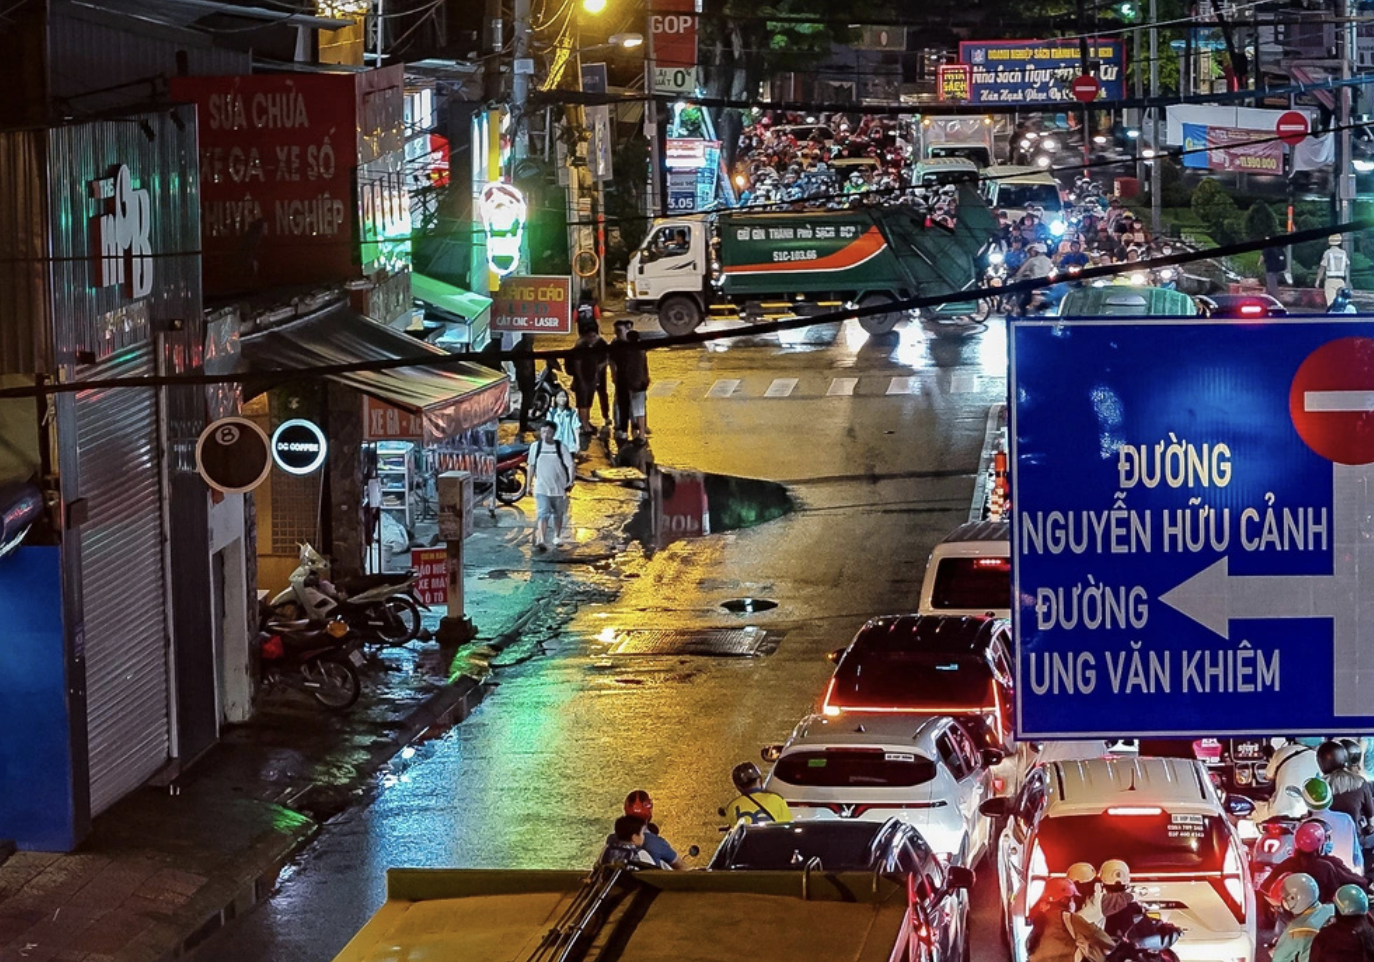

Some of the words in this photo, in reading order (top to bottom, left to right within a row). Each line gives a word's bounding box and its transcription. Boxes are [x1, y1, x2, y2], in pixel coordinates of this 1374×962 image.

[1118, 432, 1232, 488] ĐƯỜNG
[1022, 491, 1152, 555] NGUYỄN
[1162, 497, 1230, 553] HỮU
[1240, 491, 1328, 551] CẢNH
[1035, 574, 1149, 630] ĐƯỜNG
[1030, 651, 1097, 695] UNG
[1105, 640, 1171, 694] VĂN
[1182, 639, 1280, 693] KHIÊM
